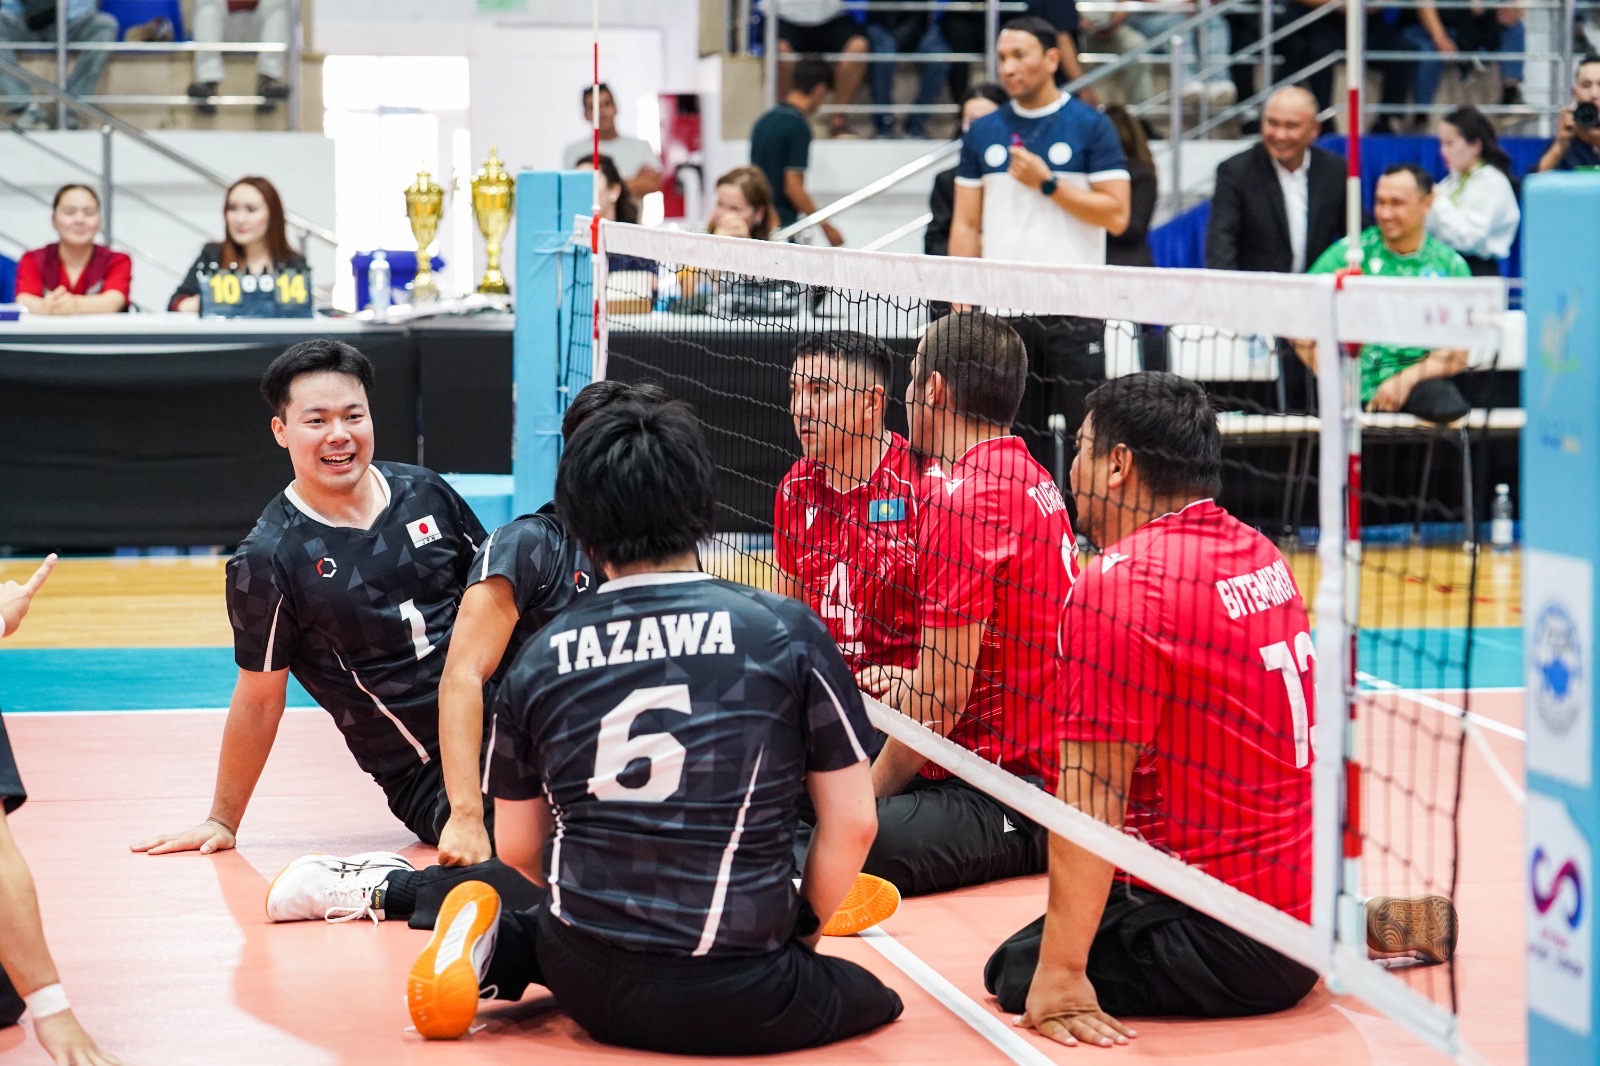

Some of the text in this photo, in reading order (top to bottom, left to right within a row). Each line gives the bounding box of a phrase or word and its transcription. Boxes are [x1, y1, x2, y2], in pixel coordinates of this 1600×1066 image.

[208, 273, 241, 304] 10
[275, 273, 308, 304] 14
[399, 598, 436, 661] 1
[820, 561, 858, 637] 4
[549, 610, 736, 675] TAZAWA
[586, 683, 692, 803] 6
